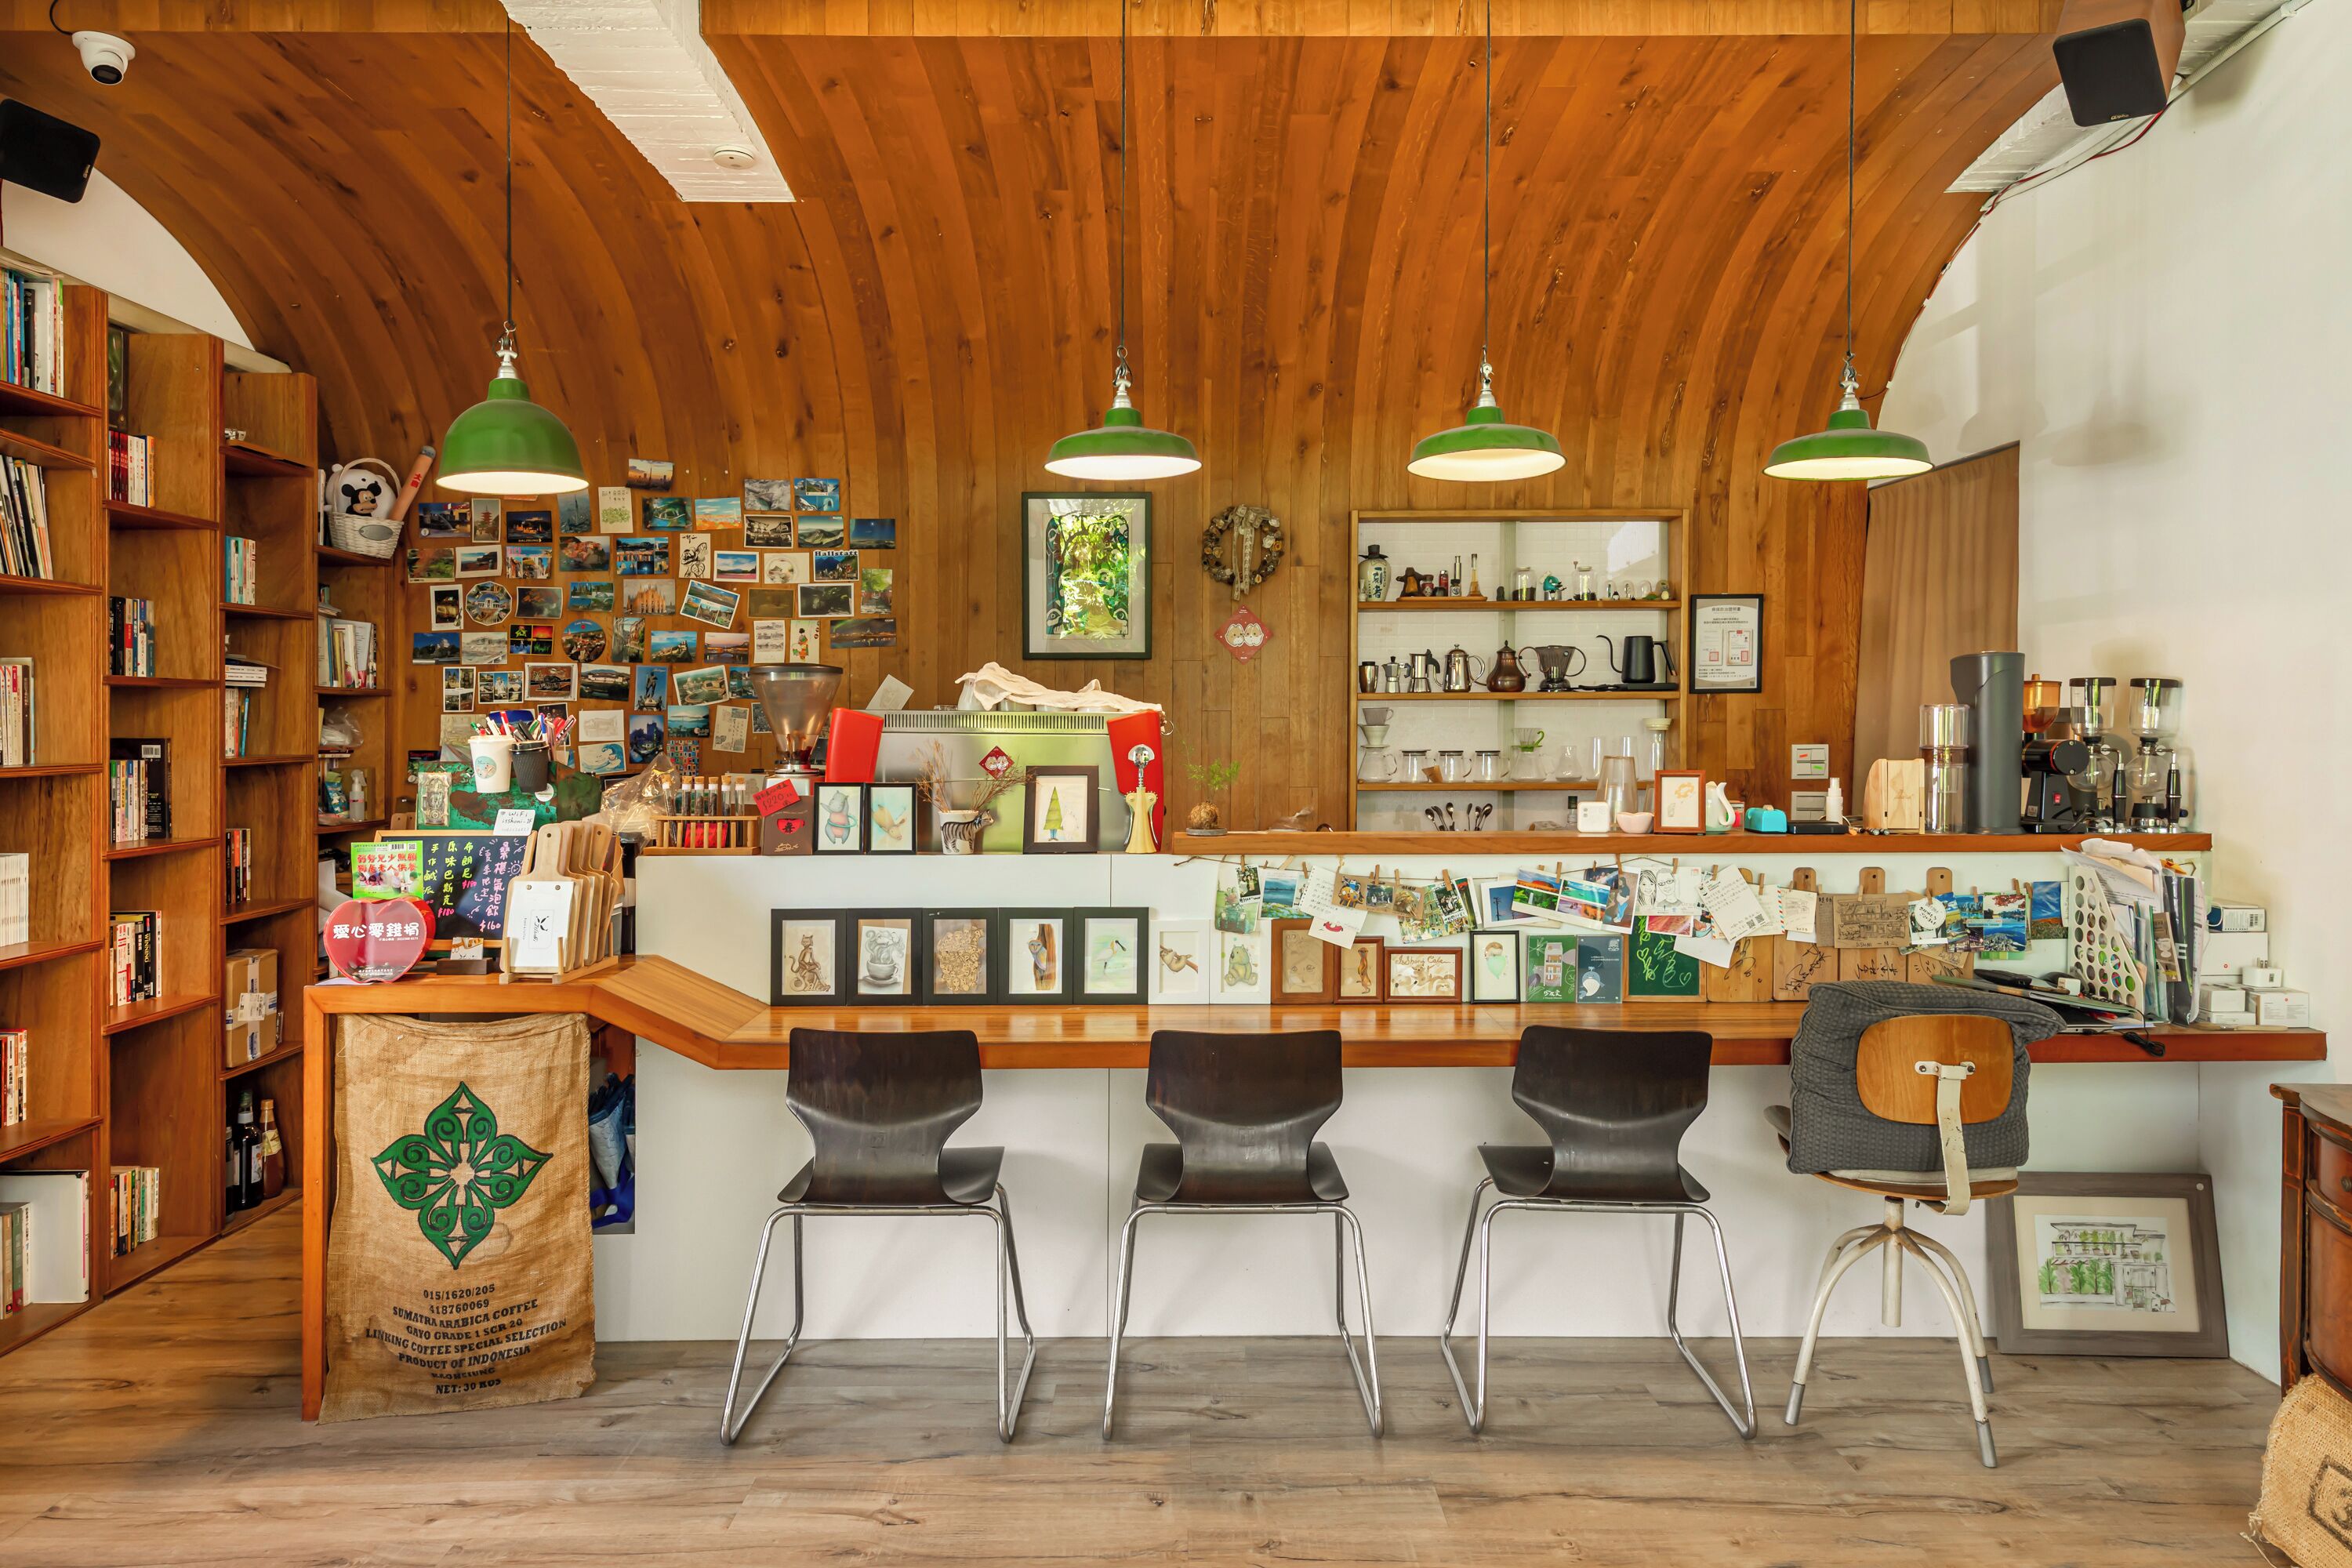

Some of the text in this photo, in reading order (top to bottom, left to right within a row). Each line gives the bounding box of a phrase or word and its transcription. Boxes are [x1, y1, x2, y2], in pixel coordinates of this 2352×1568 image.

[461, 841, 474, 879] 布朗尼
[437, 907, 456, 918] $180
[333, 922, 419, 939] 愛心零錢捐
[479, 920, 502, 932] $160
[423, 1283, 495, 1301] 015/1620/205
[393, 1298, 539, 1329] SUMATRA ARABICA COFFEE
[365, 1319, 567, 1356] LINKING COFFEE SPECIAL SELECTION
[406, 1325, 431, 1340] GAYO
[434, 1327, 472, 1341] GRADE
[483, 1323, 507, 1337] SCR
[510, 1318, 524, 1328] 20
[398, 1345, 531, 1370] PRODUCT OF INDONESIA
[436, 1383, 462, 1394] NET:
[463, 1381, 476, 1392] 30
